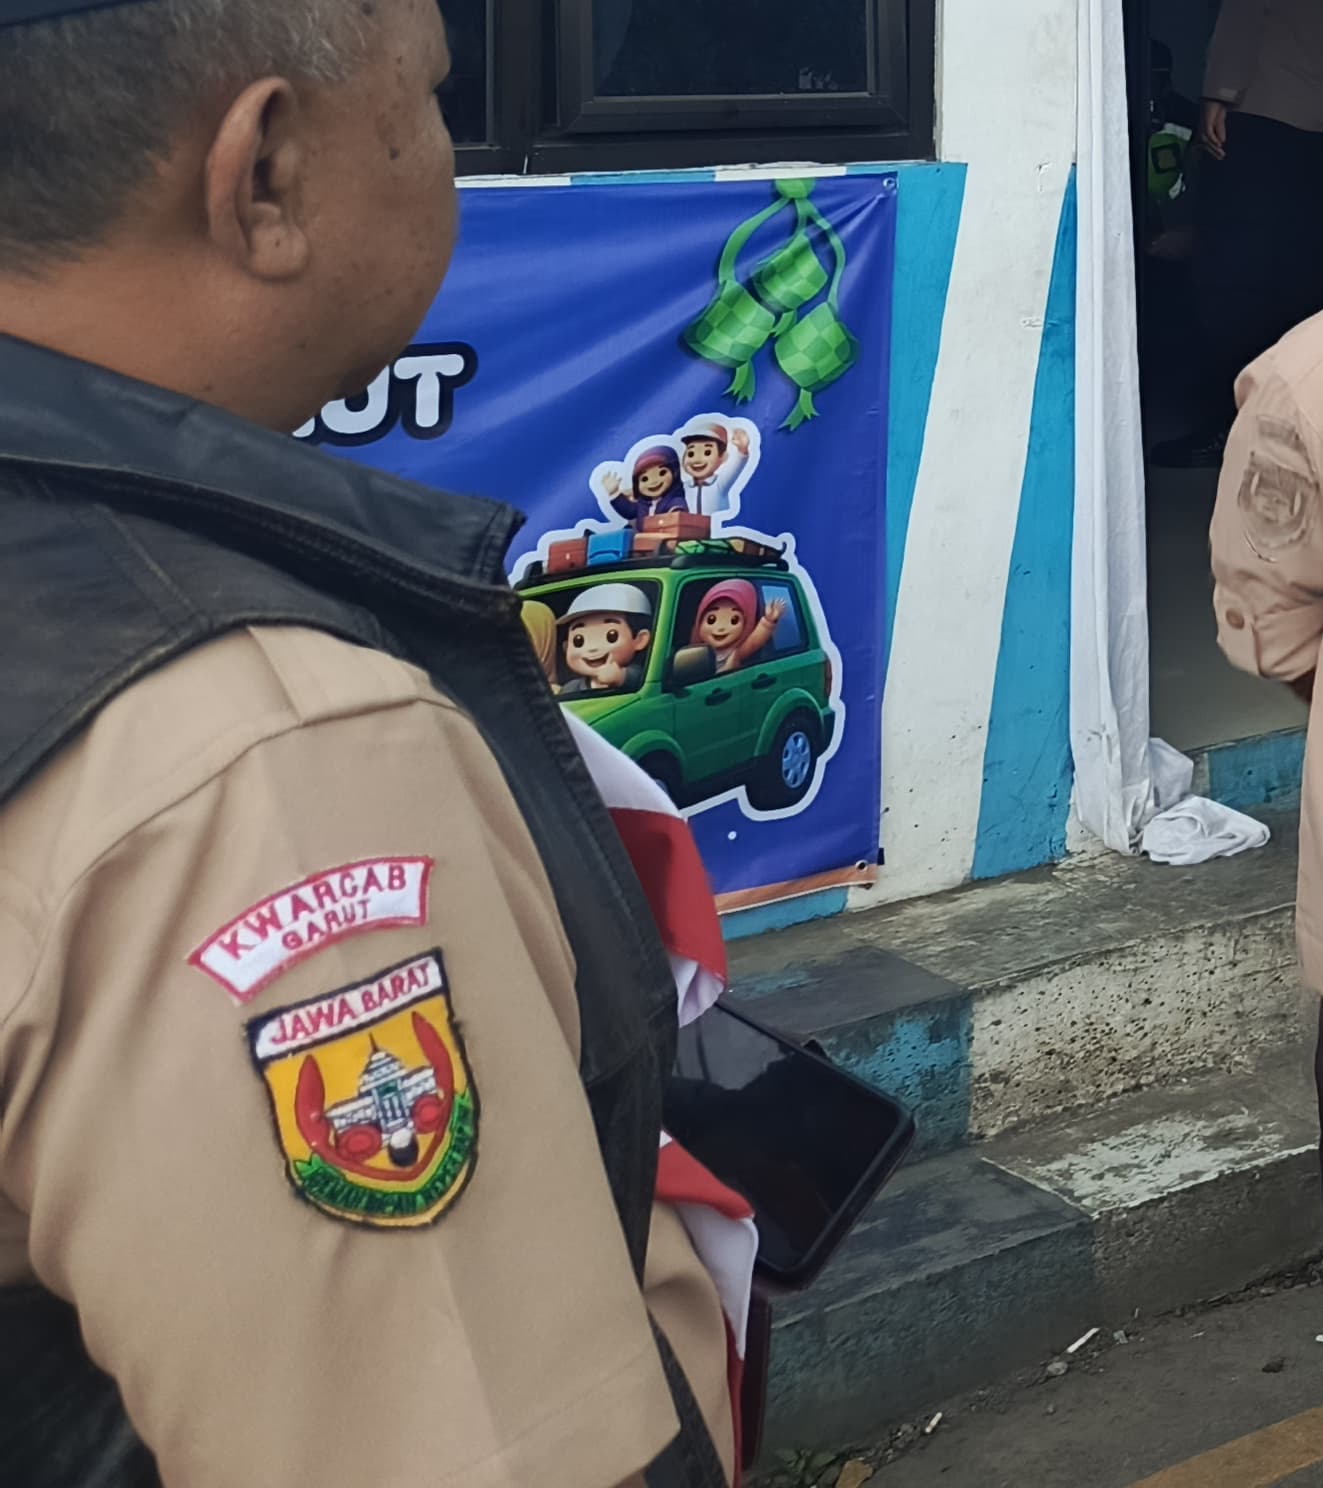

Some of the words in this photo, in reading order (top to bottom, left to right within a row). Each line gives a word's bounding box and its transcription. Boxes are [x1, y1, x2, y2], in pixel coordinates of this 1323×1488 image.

[217, 863, 407, 961] KWARCAB
[281, 899, 371, 951] GARUT
[270, 999, 361, 1046] JAWA
[361, 961, 432, 1013] BARAT
